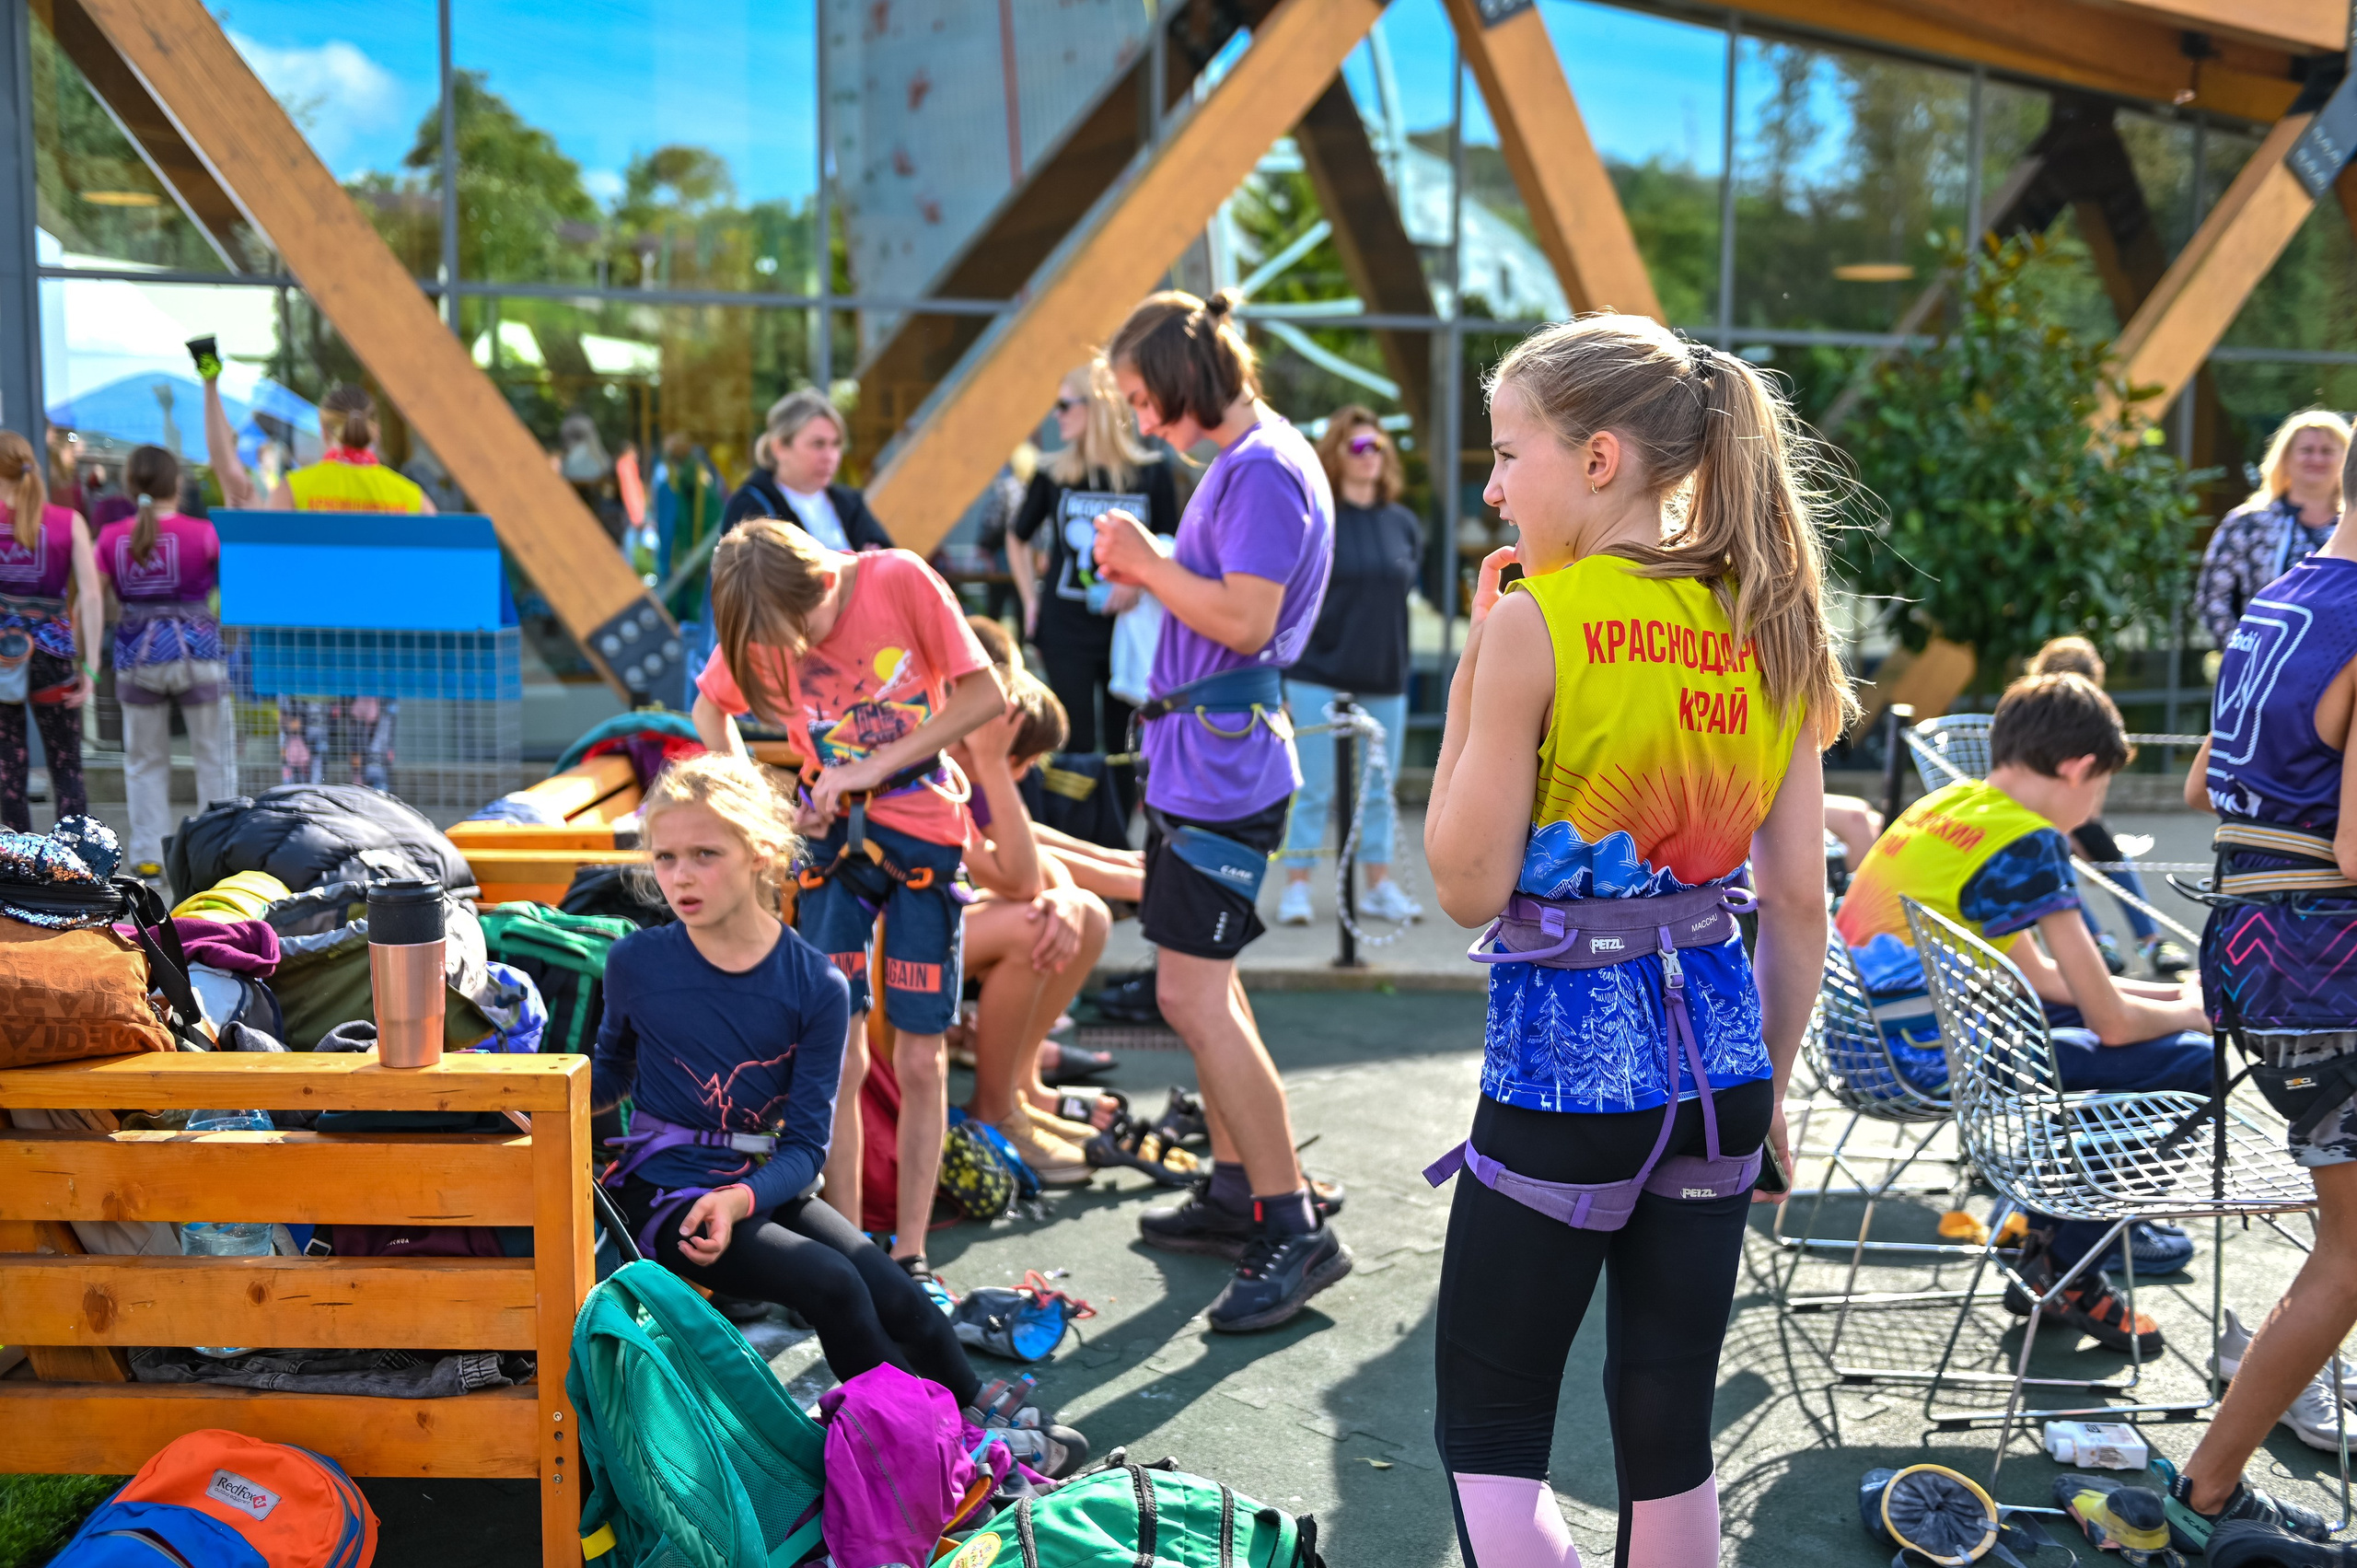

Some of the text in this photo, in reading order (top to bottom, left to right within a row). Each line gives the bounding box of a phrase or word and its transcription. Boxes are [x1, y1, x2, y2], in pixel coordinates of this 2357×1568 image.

[1679, 687, 1748, 735] КРАЙ
[1691, 912, 1718, 933] MACCHU
[1591, 937, 1625, 955] PETZL
[1682, 1188, 1717, 1199] PETZL
[217, 1477, 257, 1501] RedFox
